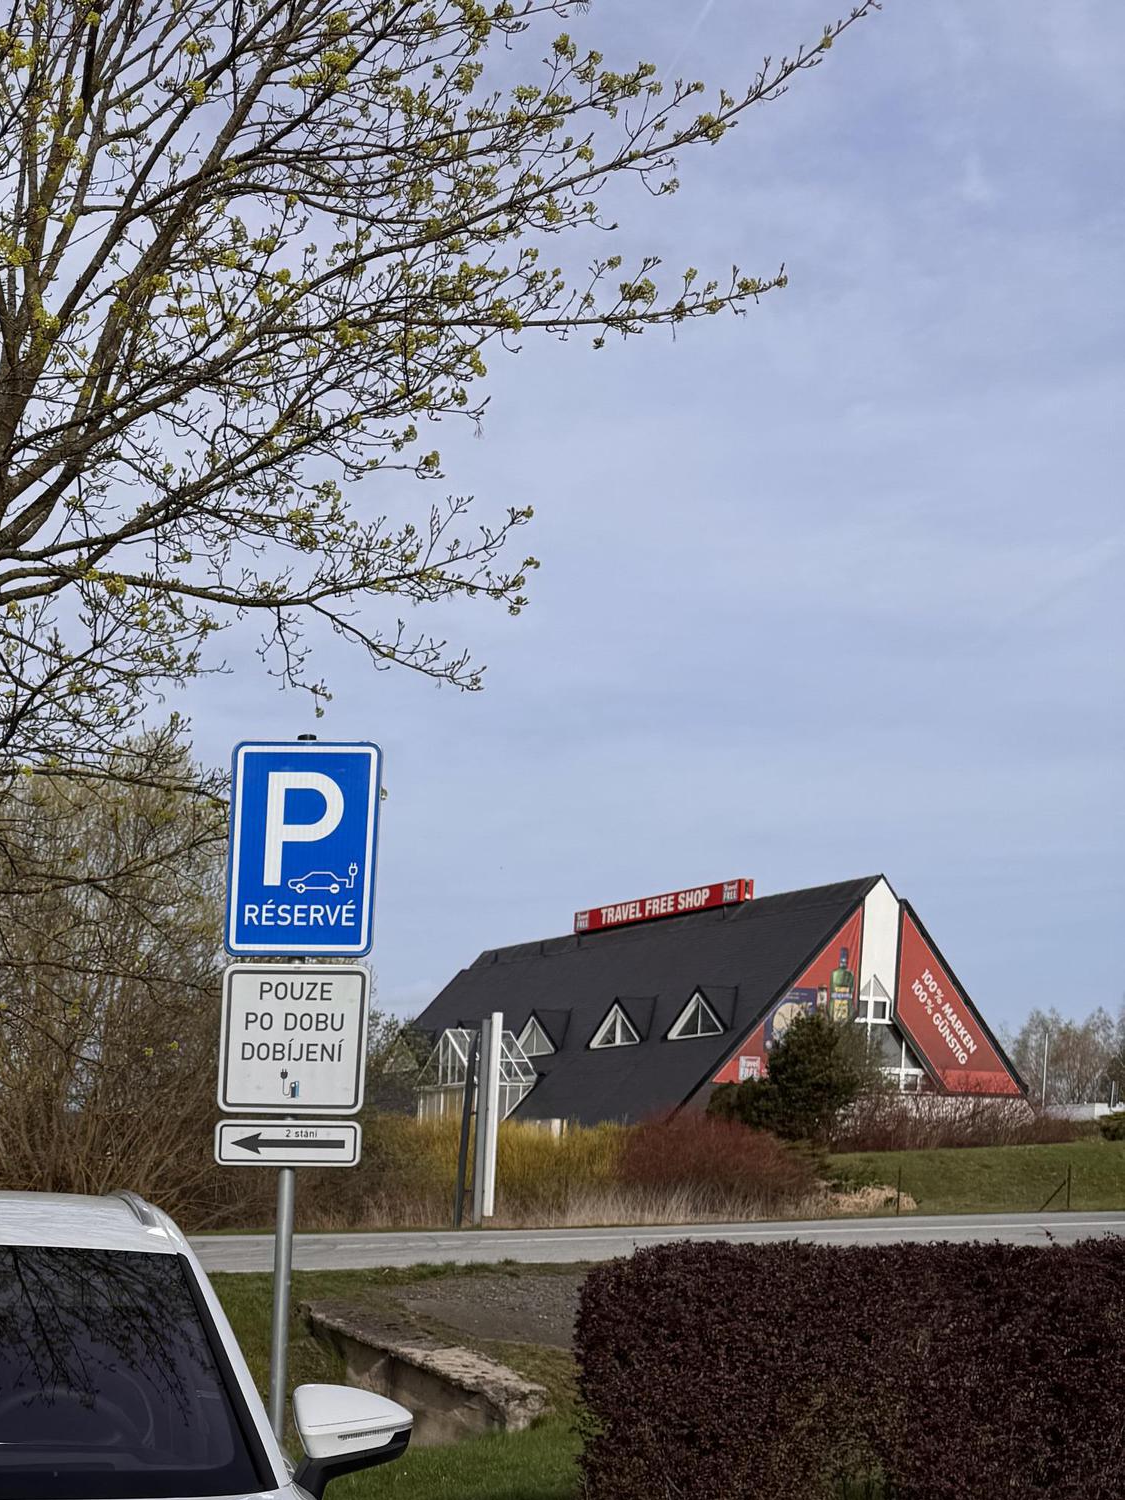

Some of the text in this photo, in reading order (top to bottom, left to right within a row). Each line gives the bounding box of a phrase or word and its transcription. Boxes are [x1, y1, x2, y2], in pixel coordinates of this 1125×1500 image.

[263, 772, 345, 886] P
[244, 899, 356, 926] RÉSERVÉ
[600, 888, 710, 925] TRAVEL FREE SHOP
[259, 981, 333, 1001] POUZE
[244, 1012, 345, 1032] PO DOBU
[911, 979, 968, 1065] 100% GÜNSTIG
[921, 968, 977, 1054] 100% MARKEN
[241, 1038, 345, 1062] DOBÍJENÍ
[285, 1129, 291, 1138] 2
